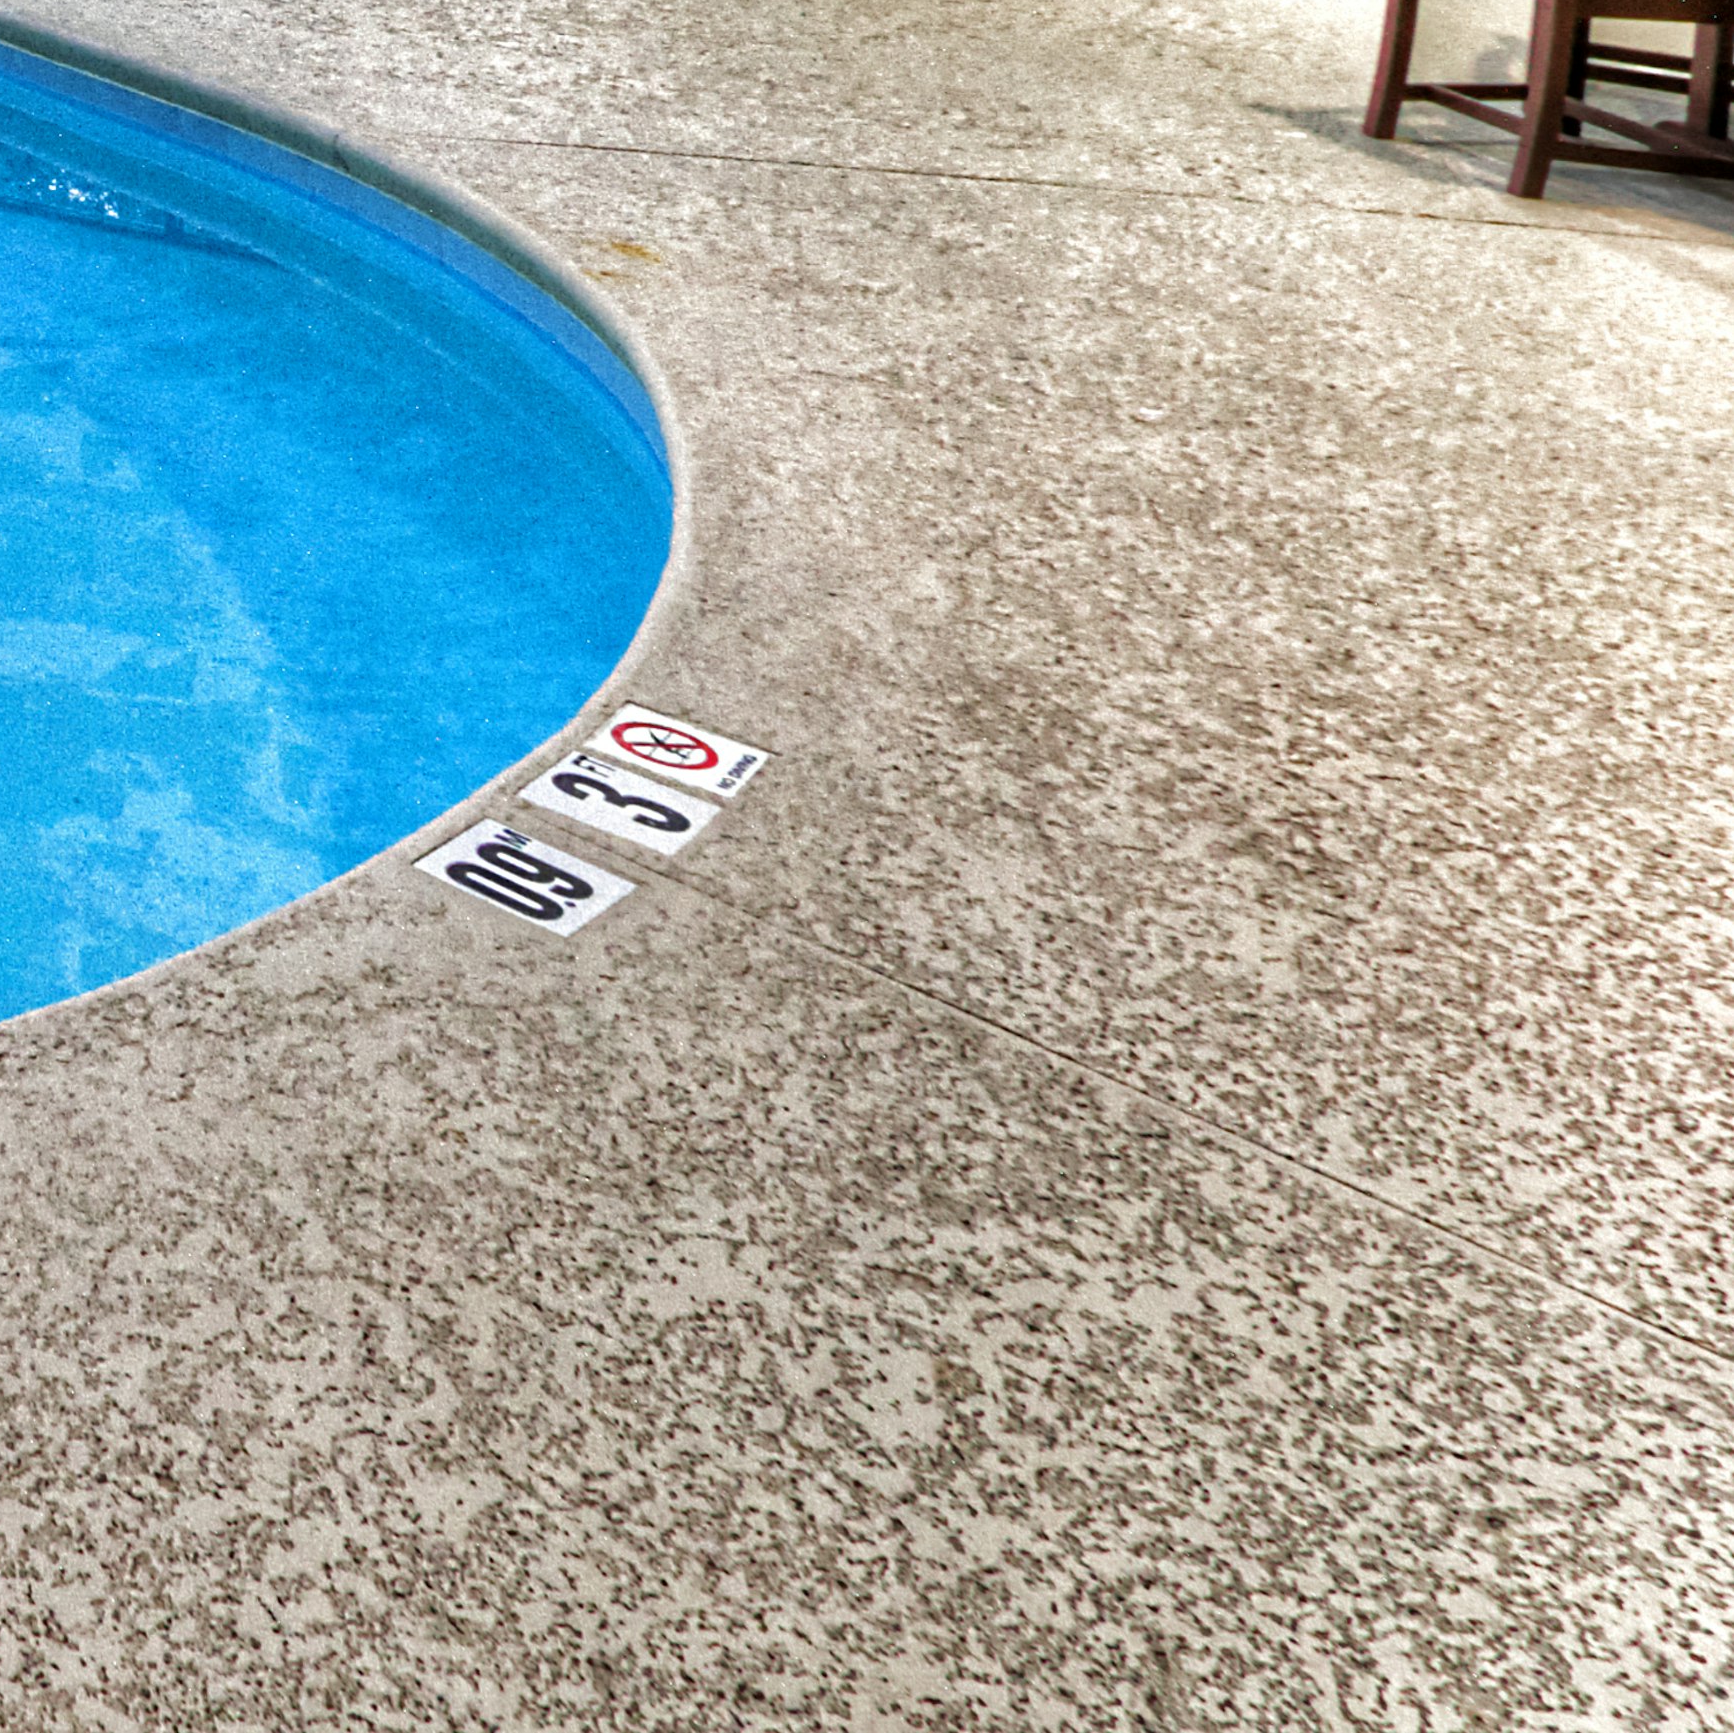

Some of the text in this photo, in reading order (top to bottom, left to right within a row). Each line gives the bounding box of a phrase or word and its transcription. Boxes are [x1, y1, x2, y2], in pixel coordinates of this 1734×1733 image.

[551, 754, 691, 833] 3 FT
[494, 828, 533, 850] M
